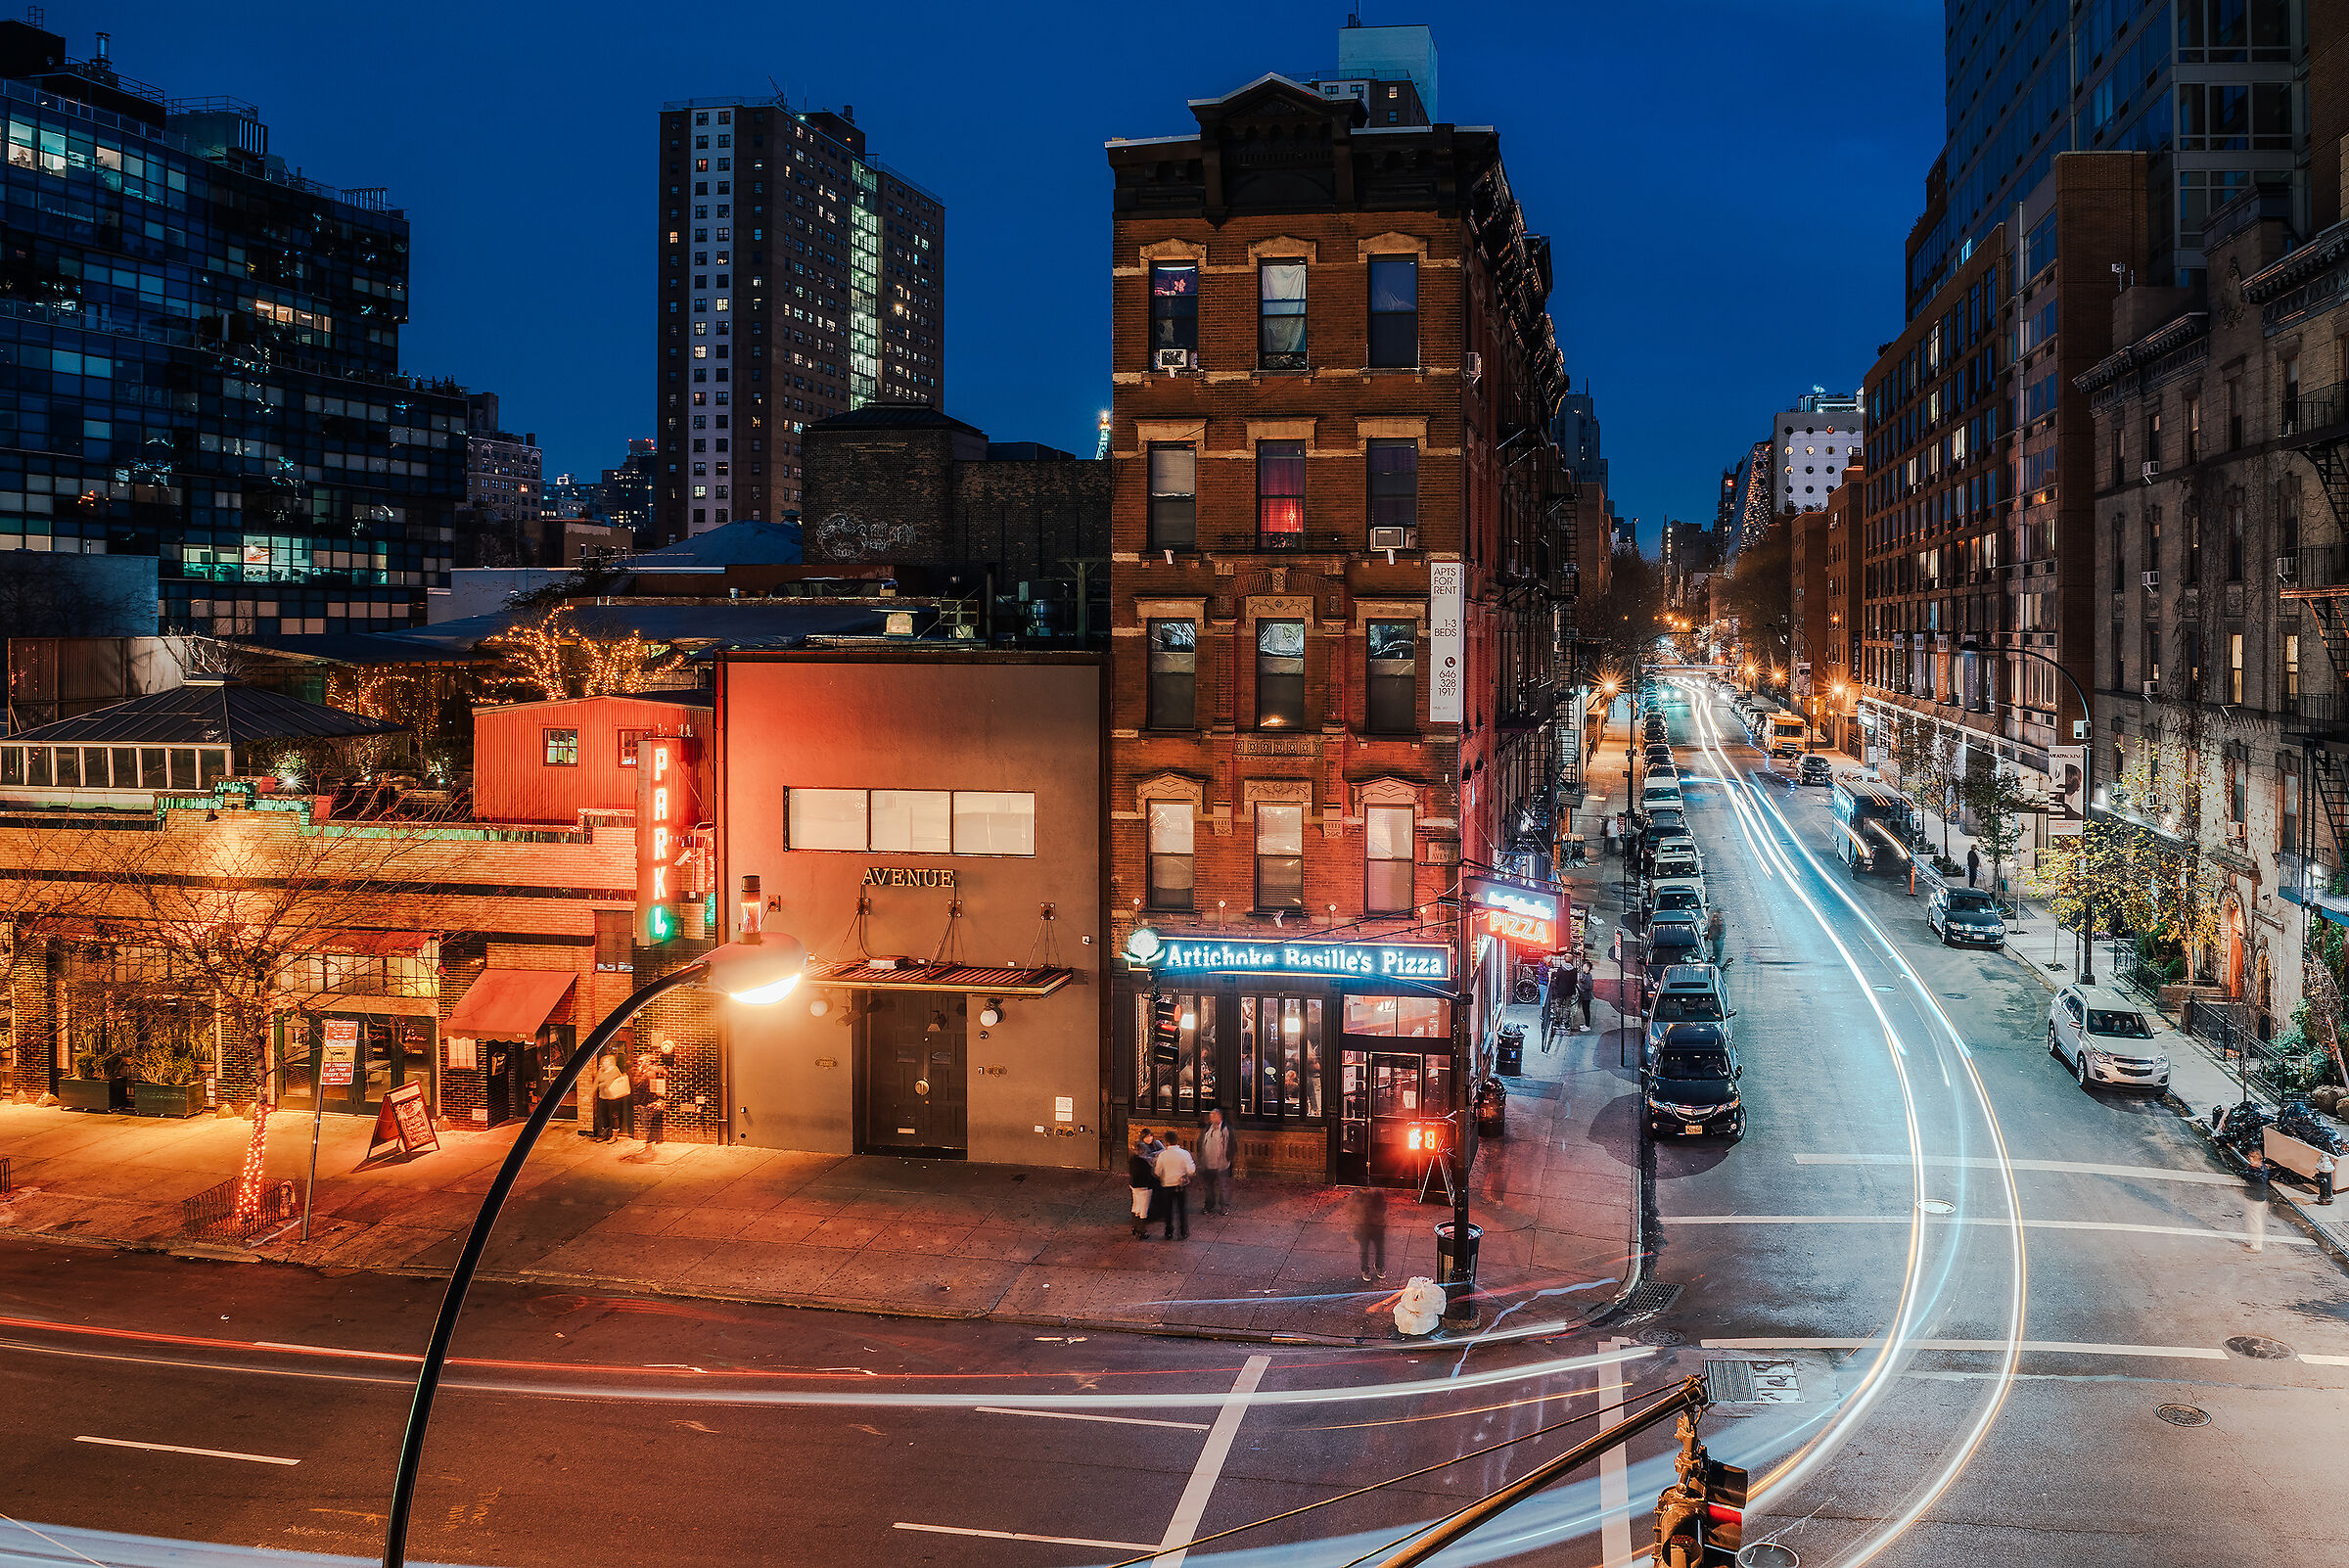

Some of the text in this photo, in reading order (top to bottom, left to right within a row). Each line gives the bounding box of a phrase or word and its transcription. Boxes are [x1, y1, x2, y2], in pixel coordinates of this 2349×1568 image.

[1433, 568, 1456, 576] APTS
[1433, 576, 1453, 585] FOR
[1433, 586, 1456, 595] RENT
[1434, 628, 1456, 637] BEDS
[1439, 669, 1456, 678] 646
[654, 748, 668, 900] PARK
[861, 867, 955, 888] AVENUE
[1489, 911, 1548, 944] PIZZA
[1167, 945, 1443, 975] Artichoke Basille's Pizza
